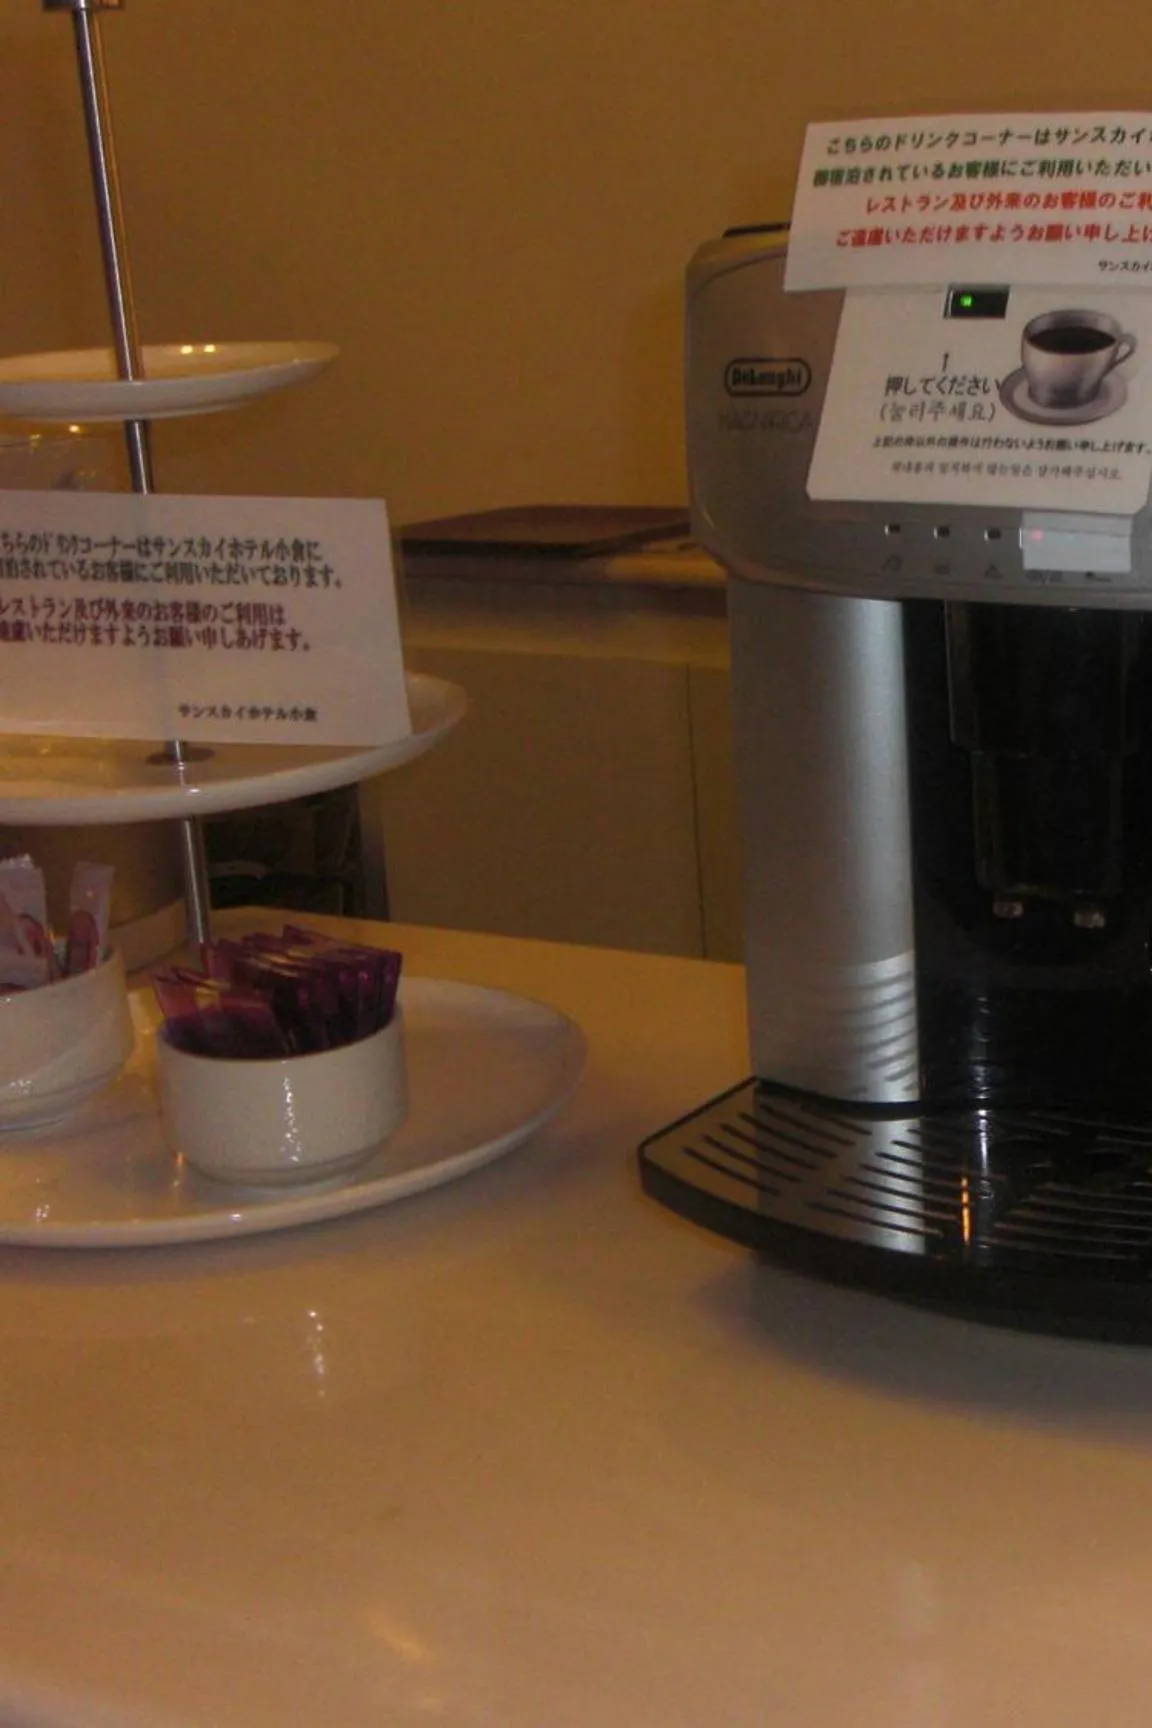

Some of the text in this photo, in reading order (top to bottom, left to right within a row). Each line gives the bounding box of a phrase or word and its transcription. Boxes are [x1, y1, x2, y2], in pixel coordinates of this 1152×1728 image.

[884, 373, 1001, 396] 押してください
[0, 557, 343, 588] 泊されているお客様にご利用いただいております。
